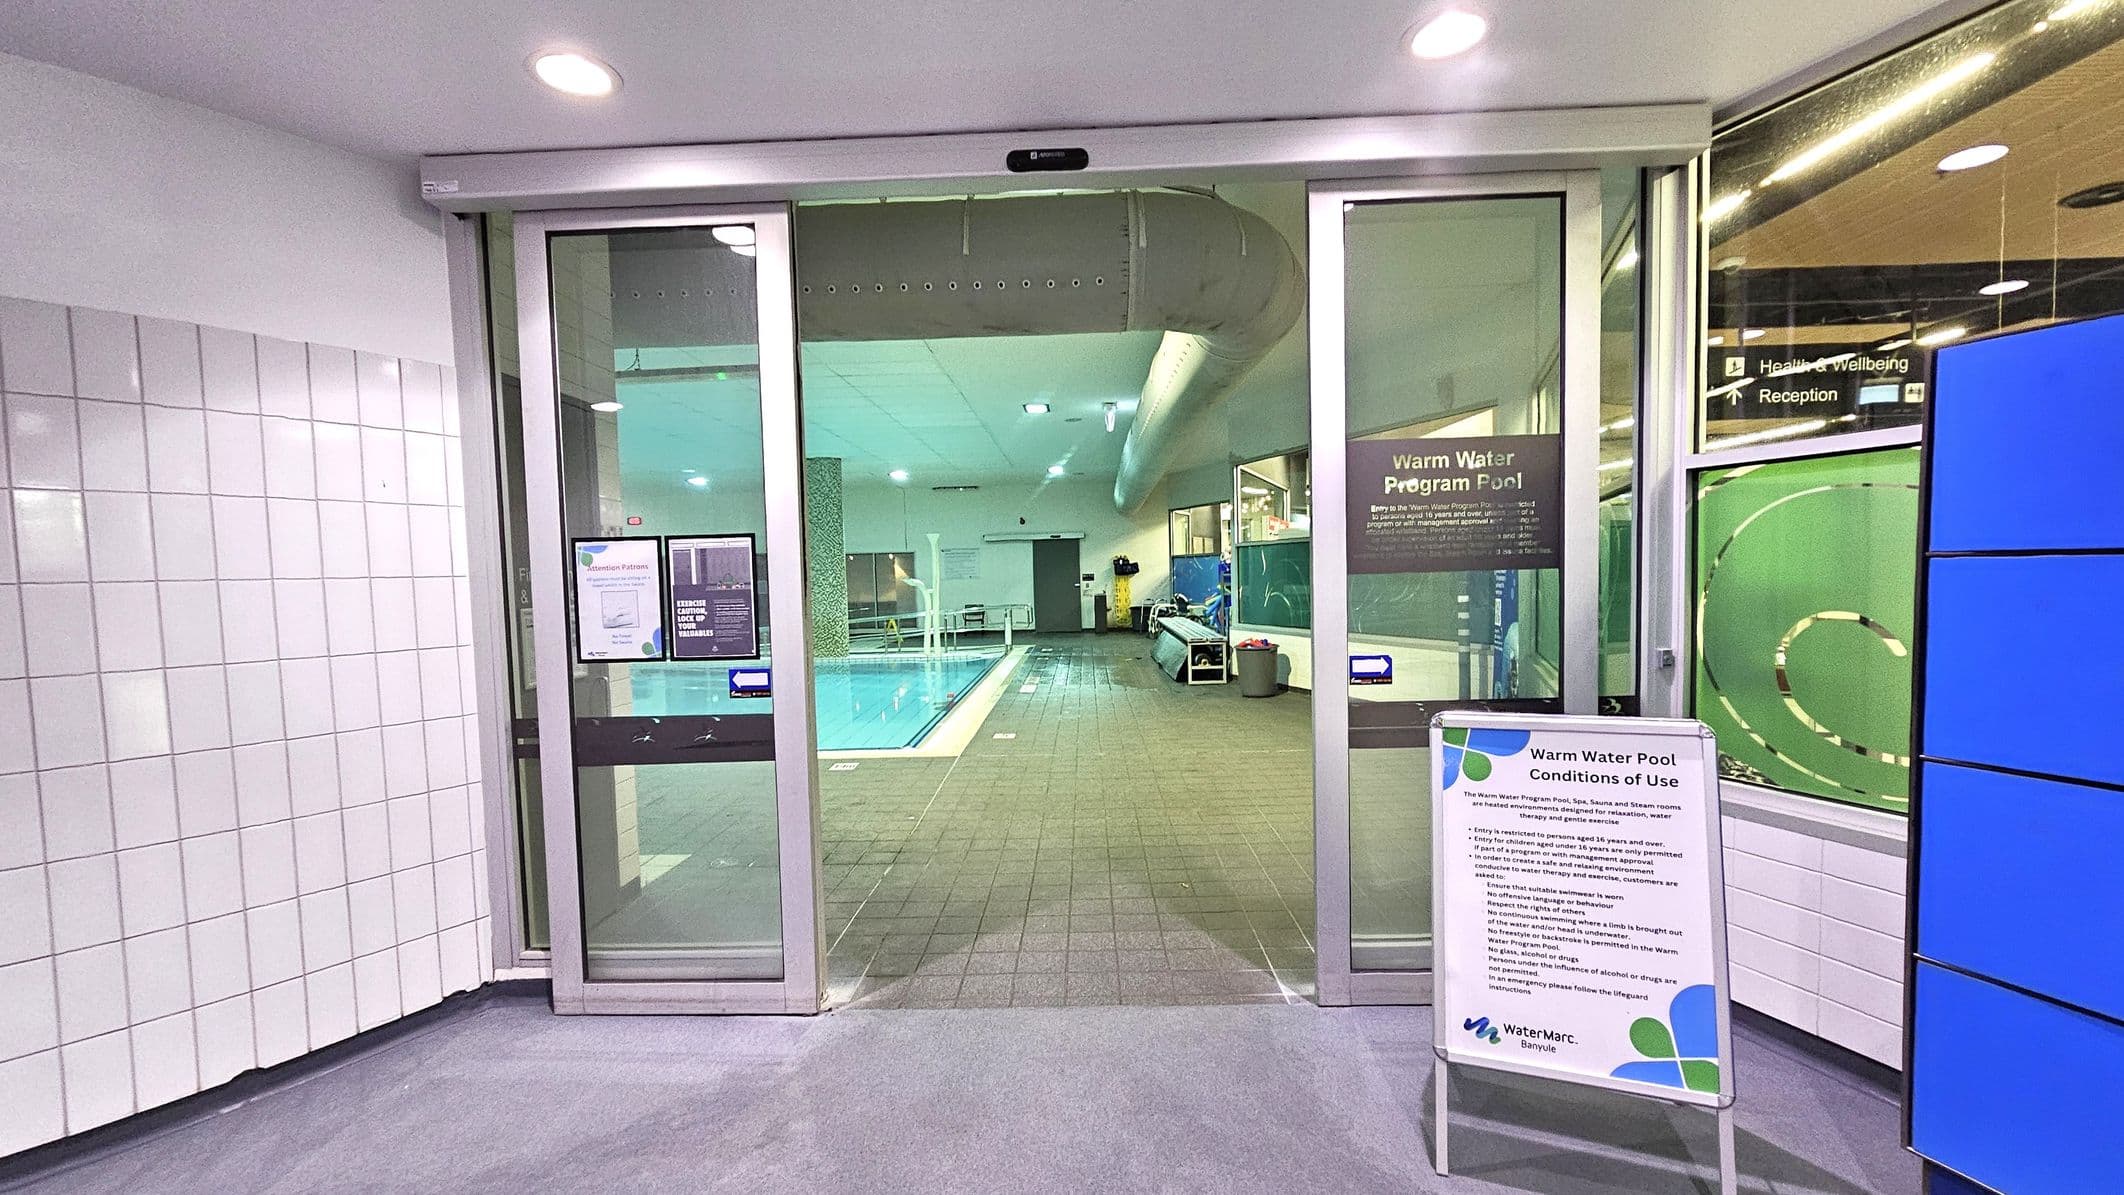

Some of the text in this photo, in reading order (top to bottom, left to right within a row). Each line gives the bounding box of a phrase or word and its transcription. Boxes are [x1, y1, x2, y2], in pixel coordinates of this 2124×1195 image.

[1832, 356, 1909, 373] Wellbeing
[1759, 388, 1838, 406] Reception
[1392, 450, 1515, 470] Warm Water
[1384, 471, 1522, 496] Program Pool
[1434, 511, 1452, 519] years
[587, 563, 649, 572] Attention Patrons
[677, 599, 706, 607] EXERCISE
[677, 607, 708, 615] CAUTION,
[678, 622, 696, 630] YOUR
[678, 629, 714, 638] VALUABLES
[1529, 747, 1677, 766] Warm Water Pool
[1529, 768, 1680, 787] Conditions of Use
[1520, 794, 1551, 802] Program
[1589, 798, 1613, 806] Sauna
[1484, 800, 1508, 808] heated
[1509, 803, 1559, 811] environments
[1560, 806, 1593, 814] designed
[1519, 812, 1547, 821] therapy
[1473, 826, 1492, 835] Entry
[1473, 835, 1493, 844] Entry
[1505, 838, 1535, 846] children
[1624, 848, 1641, 856] only
[1643, 850, 1682, 858] permitted
[1474, 863, 1510, 871] conducive
[1542, 868, 1571, 878] therapy
[1622, 876, 1664, 885] customers
[1486, 881, 1510, 889] Ensure
[1528, 886, 1557, 894] suitable
[1558, 889, 1595, 897] swimwear
[1596, 891, 1603, 899] is
[1487, 899, 1515, 908] Respect
[1529, 904, 1551, 912] rights
[1498, 891, 1531, 900] offensive
[1532, 895, 1565, 905] language
[1575, 899, 1613, 909] behaviour
[1556, 925, 1575, 933] head
[1487, 936, 1509, 944] Water
[1510, 939, 1541, 948] Program
[1498, 928, 1530, 938] freestyle
[1541, 933, 1582, 943] backstroke
[1590, 940, 1629, 949] permitted
[1639, 944, 1653, 952] the
[1654, 946, 1678, 955] Warm
[1520, 950, 1547, 958] alcohol
[1558, 954, 1579, 963] drugs
[1488, 983, 1531, 995] instructions
[1507, 977, 1547, 988] emergency
[1548, 982, 1572, 990] please
[1573, 984, 1597, 993] follow
[1598, 987, 1612, 996] the
[1613, 989, 1648, 1000] lifeguard
[1520, 1039, 1557, 1053] Banyule
